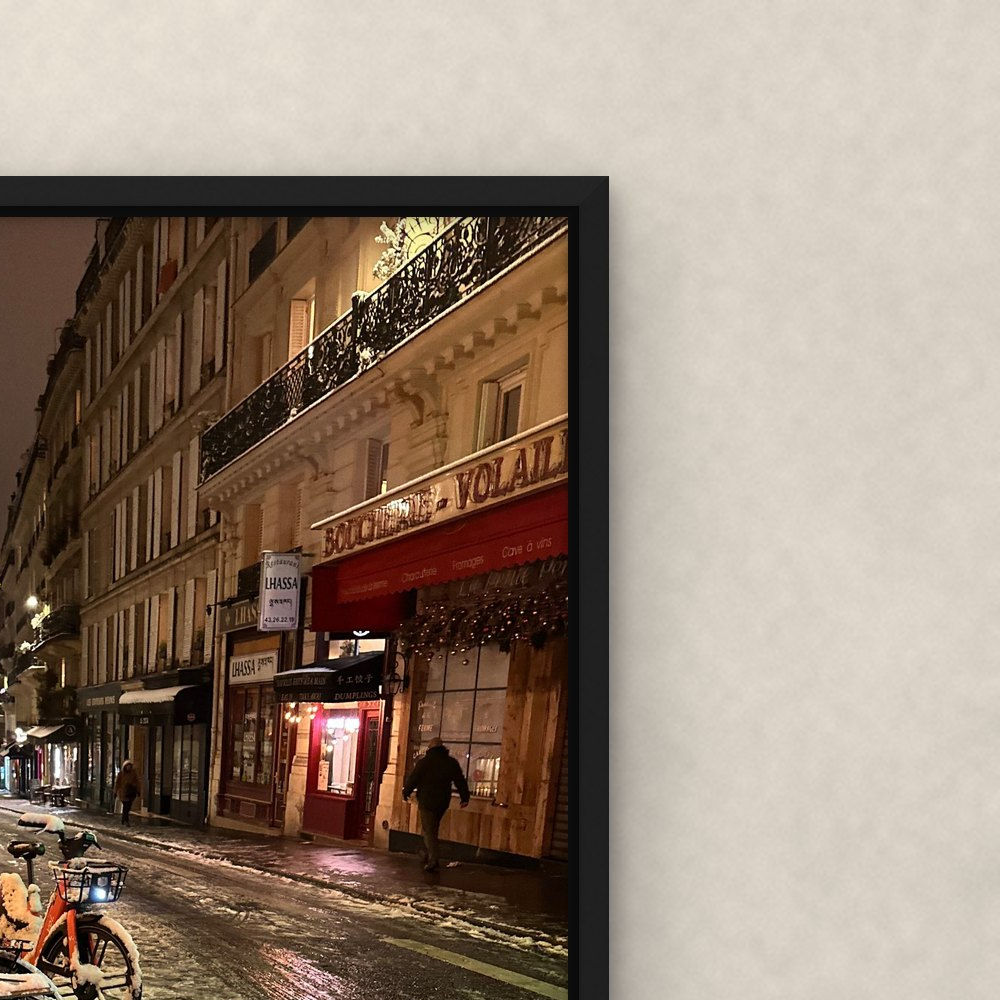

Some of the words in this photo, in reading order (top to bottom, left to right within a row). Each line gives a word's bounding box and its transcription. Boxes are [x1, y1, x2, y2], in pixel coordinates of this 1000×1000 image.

[502, 544, 523, 558] Cave
[537, 537, 553, 549] vins
[265, 577, 298, 590] LHASSA
[235, 604, 258, 625] LHAS
[232, 659, 255, 677] LHASSA
[334, 690, 377, 700] DUMPLINGS
